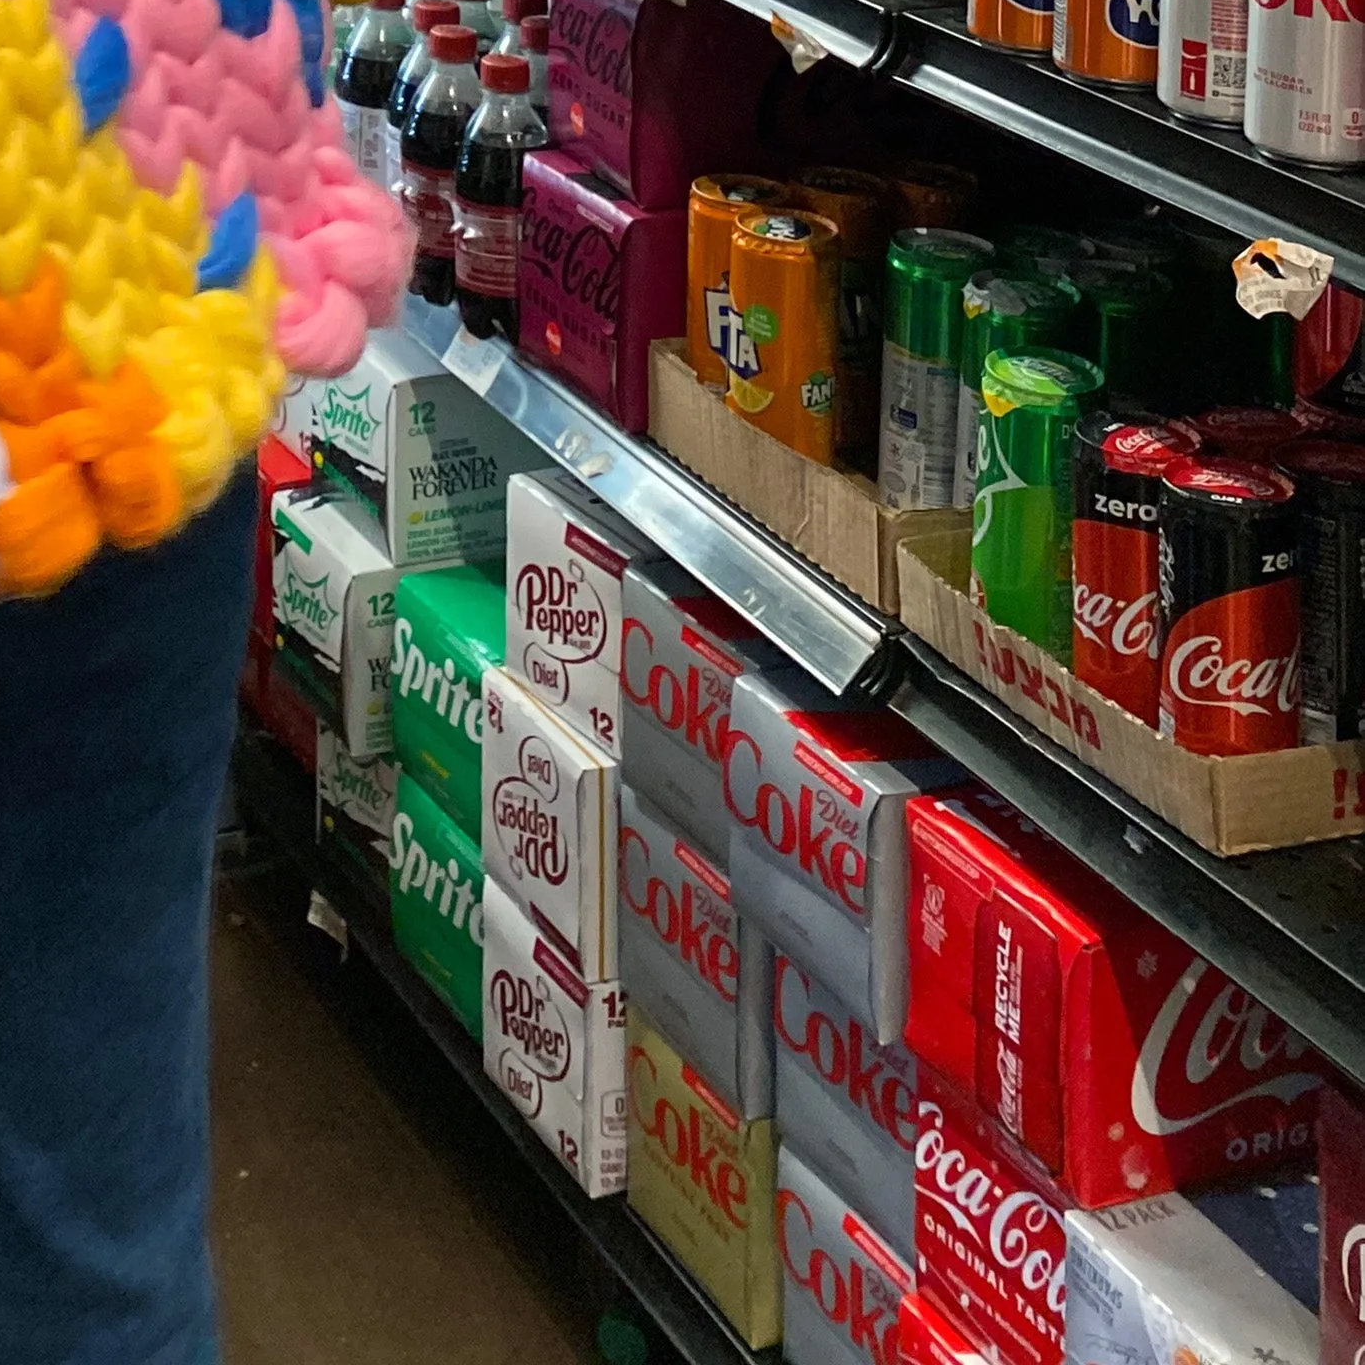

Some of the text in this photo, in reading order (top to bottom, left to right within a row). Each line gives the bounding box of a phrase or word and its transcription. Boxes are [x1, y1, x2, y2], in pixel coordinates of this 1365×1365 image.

[324, 387, 370, 441] Sprite
[409, 401, 436, 425] 12
[408, 457, 498, 482] WAKANDA
[412, 472, 497, 500] FOREVER
[1094, 493, 1157, 523] zero
[284, 575, 331, 627] Sprite
[368, 594, 394, 616] 12
[516, 564, 599, 644] Dr Pepper
[392, 617, 485, 746] Sprite
[533, 661, 559, 689] Diet
[590, 707, 614, 743] 12
[724, 728, 870, 915] Coke
[817, 787, 862, 840] Diet
[621, 825, 739, 1003] Coke
[994, 921, 1014, 1029] RECYCLE
[491, 969, 566, 1064] Dr Pepper
[1006, 999, 1023, 1046] ME
[772, 954, 919, 1155] Coke
[507, 1064, 533, 1104] Diet
[558, 1129, 579, 1167] 12
[631, 1044, 748, 1232] Coke
[1126, 1199, 1175, 1227] PACK
[923, 1215, 1015, 1302] ORIGINAL
